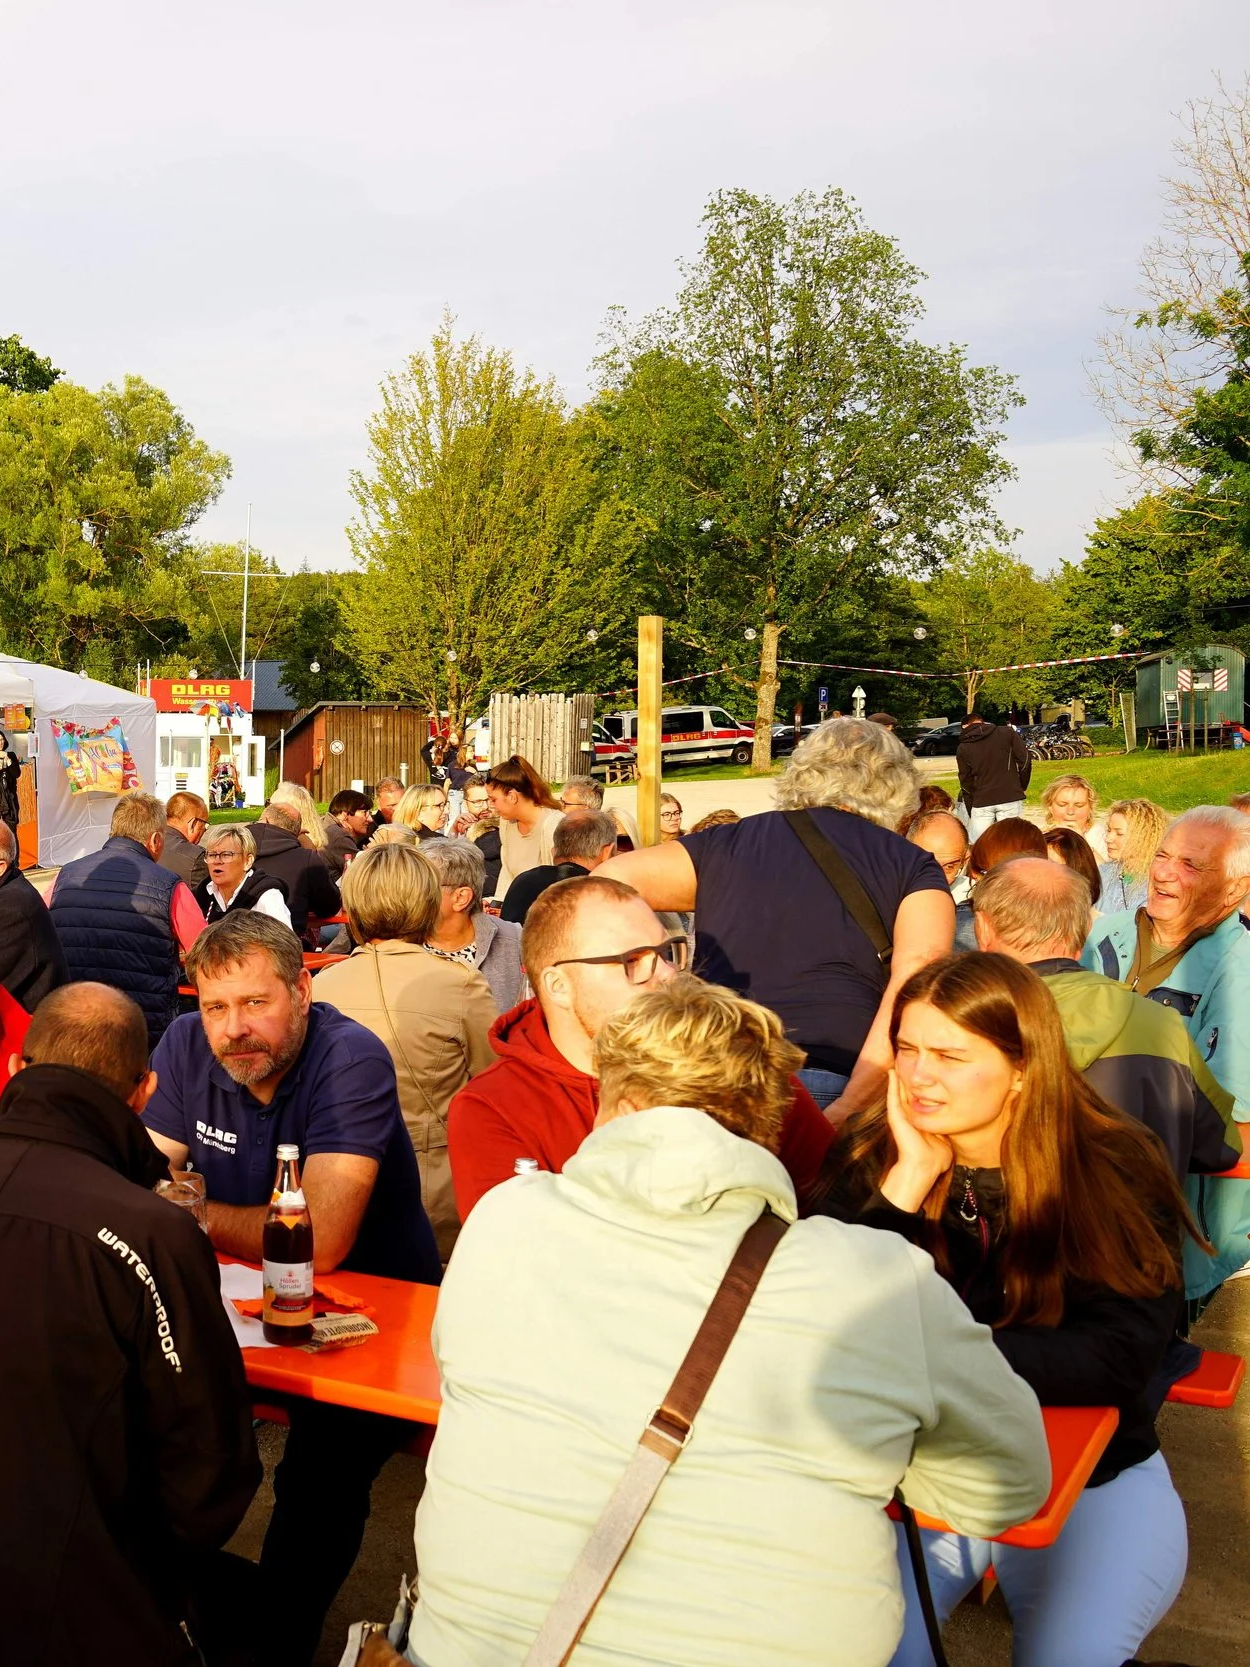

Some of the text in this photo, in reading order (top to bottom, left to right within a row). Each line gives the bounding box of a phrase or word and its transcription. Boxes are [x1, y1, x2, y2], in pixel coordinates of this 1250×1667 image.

[171, 684, 230, 695] DLRG
[821, 689, 827, 700] P
[672, 733, 701, 742] DLRG
[196, 1120, 238, 1144] DLRG
